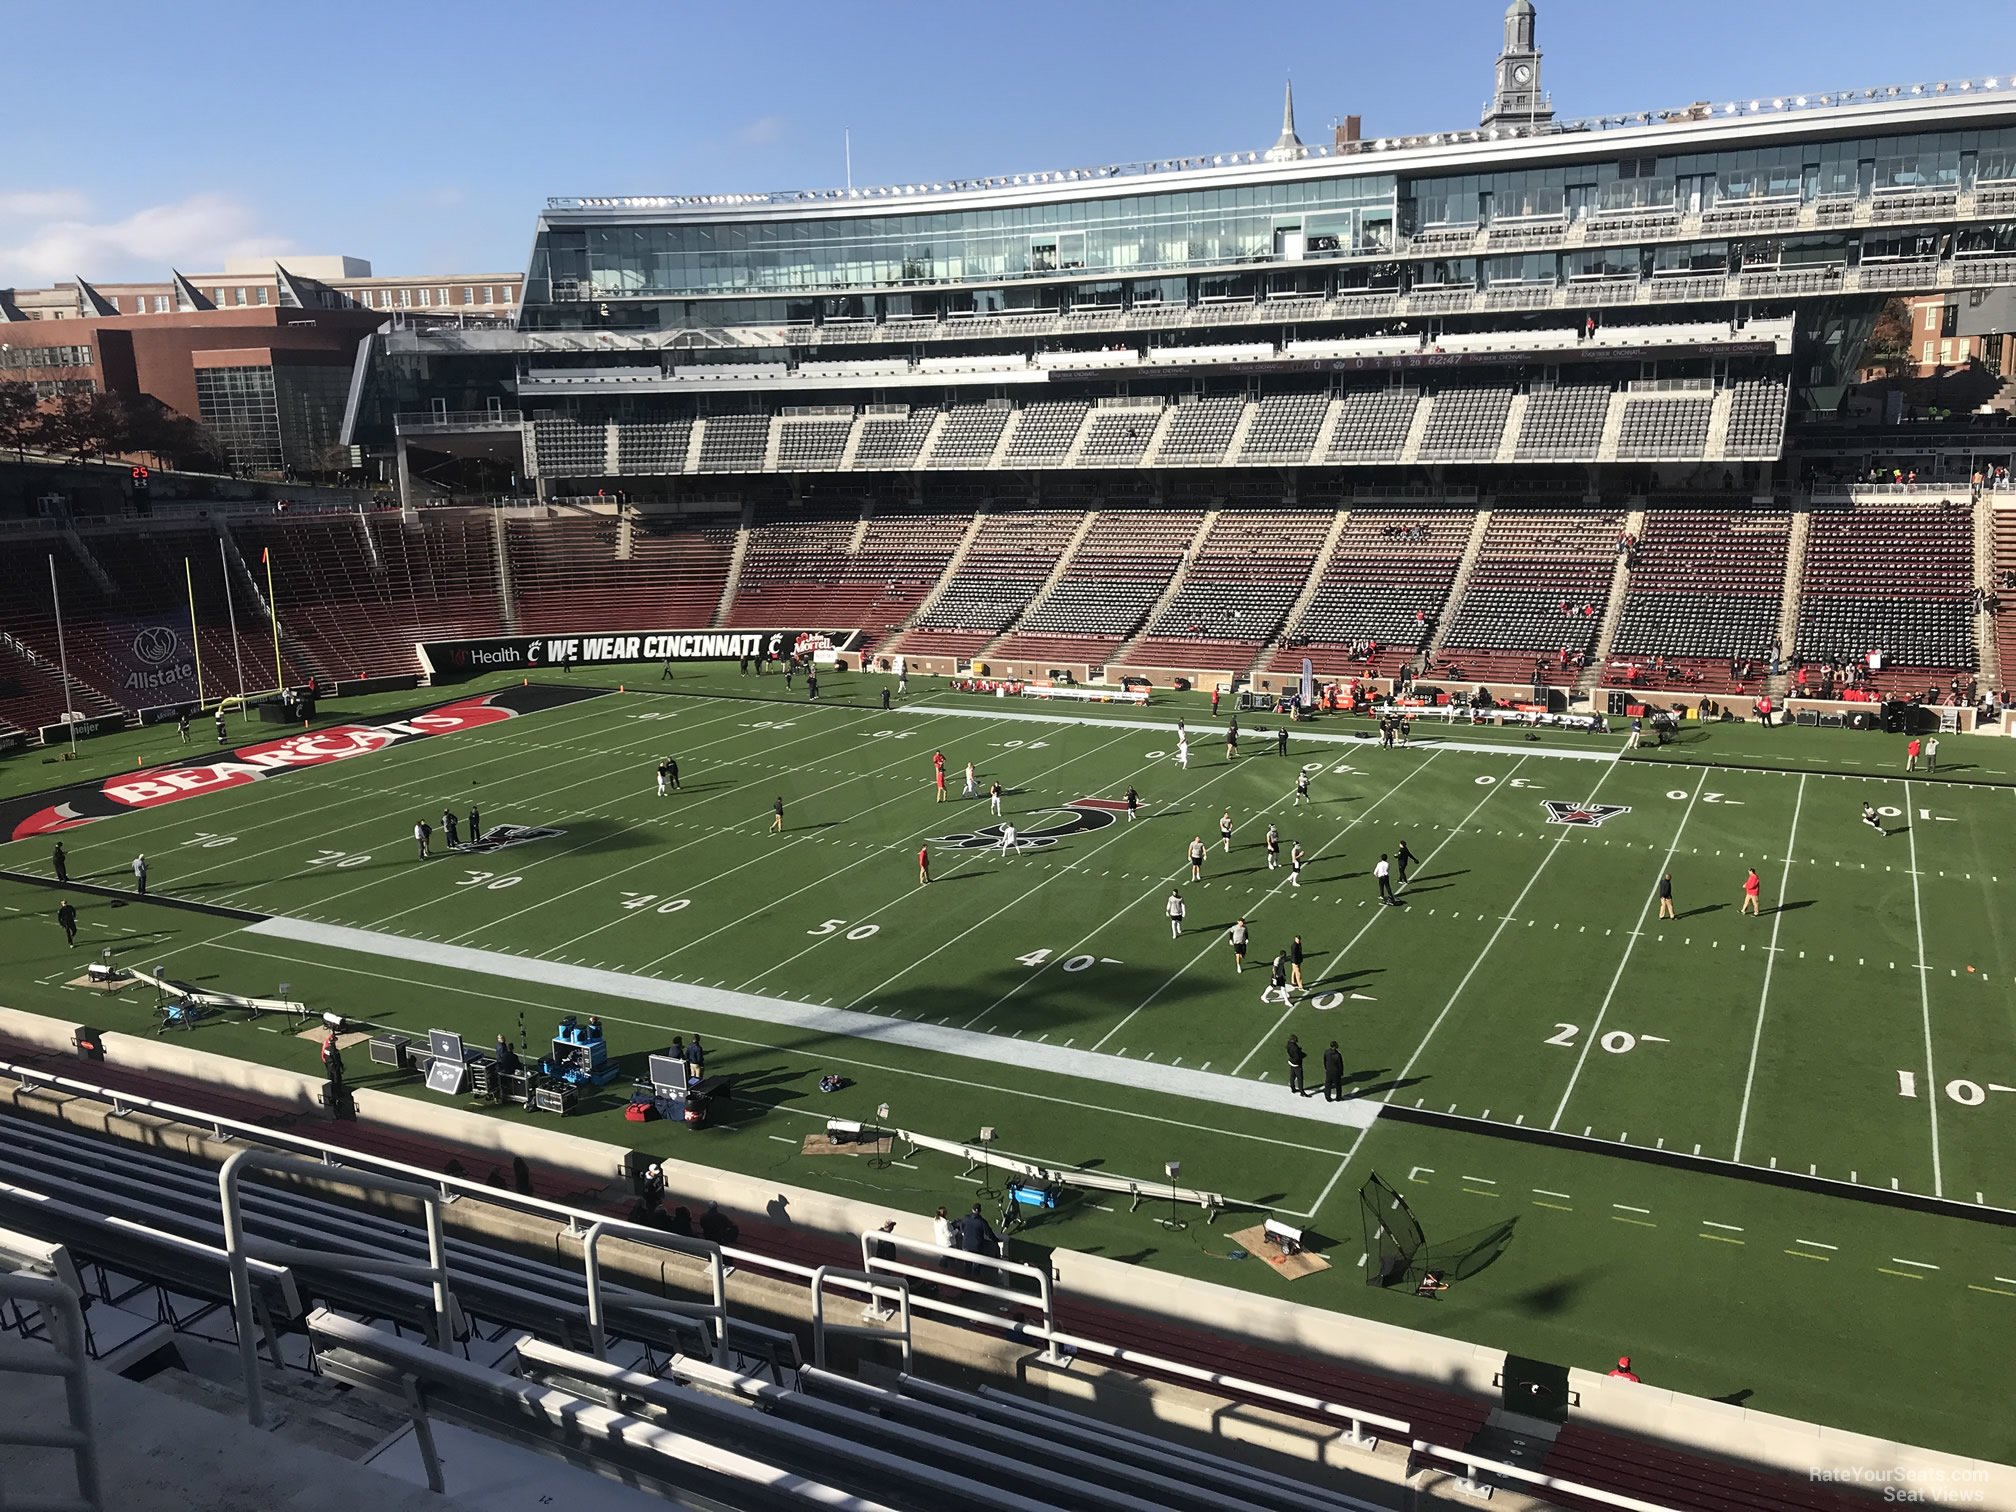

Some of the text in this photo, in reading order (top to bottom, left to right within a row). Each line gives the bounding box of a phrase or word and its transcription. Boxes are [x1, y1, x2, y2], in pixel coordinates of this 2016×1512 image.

[1313, 360, 1320, 370] 0
[1356, 358, 1363, 368] 0
[1410, 358, 1421, 367] 20
[1428, 354, 1462, 365] 62:47
[133, 467, 148, 478] 25
[793, 637, 830, 653] Morrell
[806, 632, 824, 642] John
[471, 647, 520, 664] Health
[548, 639, 579, 662] WE
[583, 637, 641, 660] WEAR
[643, 634, 763, 657] CINCINNATI
[124, 664, 192, 688] Allstate
[99, 711, 464, 804] BEARCATS
[180, 834, 238, 848] 10
[305, 850, 372, 867] 20
[456, 872, 523, 890] 30
[621, 894, 691, 913] 40
[807, 919, 880, 940] 50
[1015, 948, 1095, 972] 40
[1543, 1023, 1637, 1054] 20
[1897, 1070, 1986, 1106] 10
